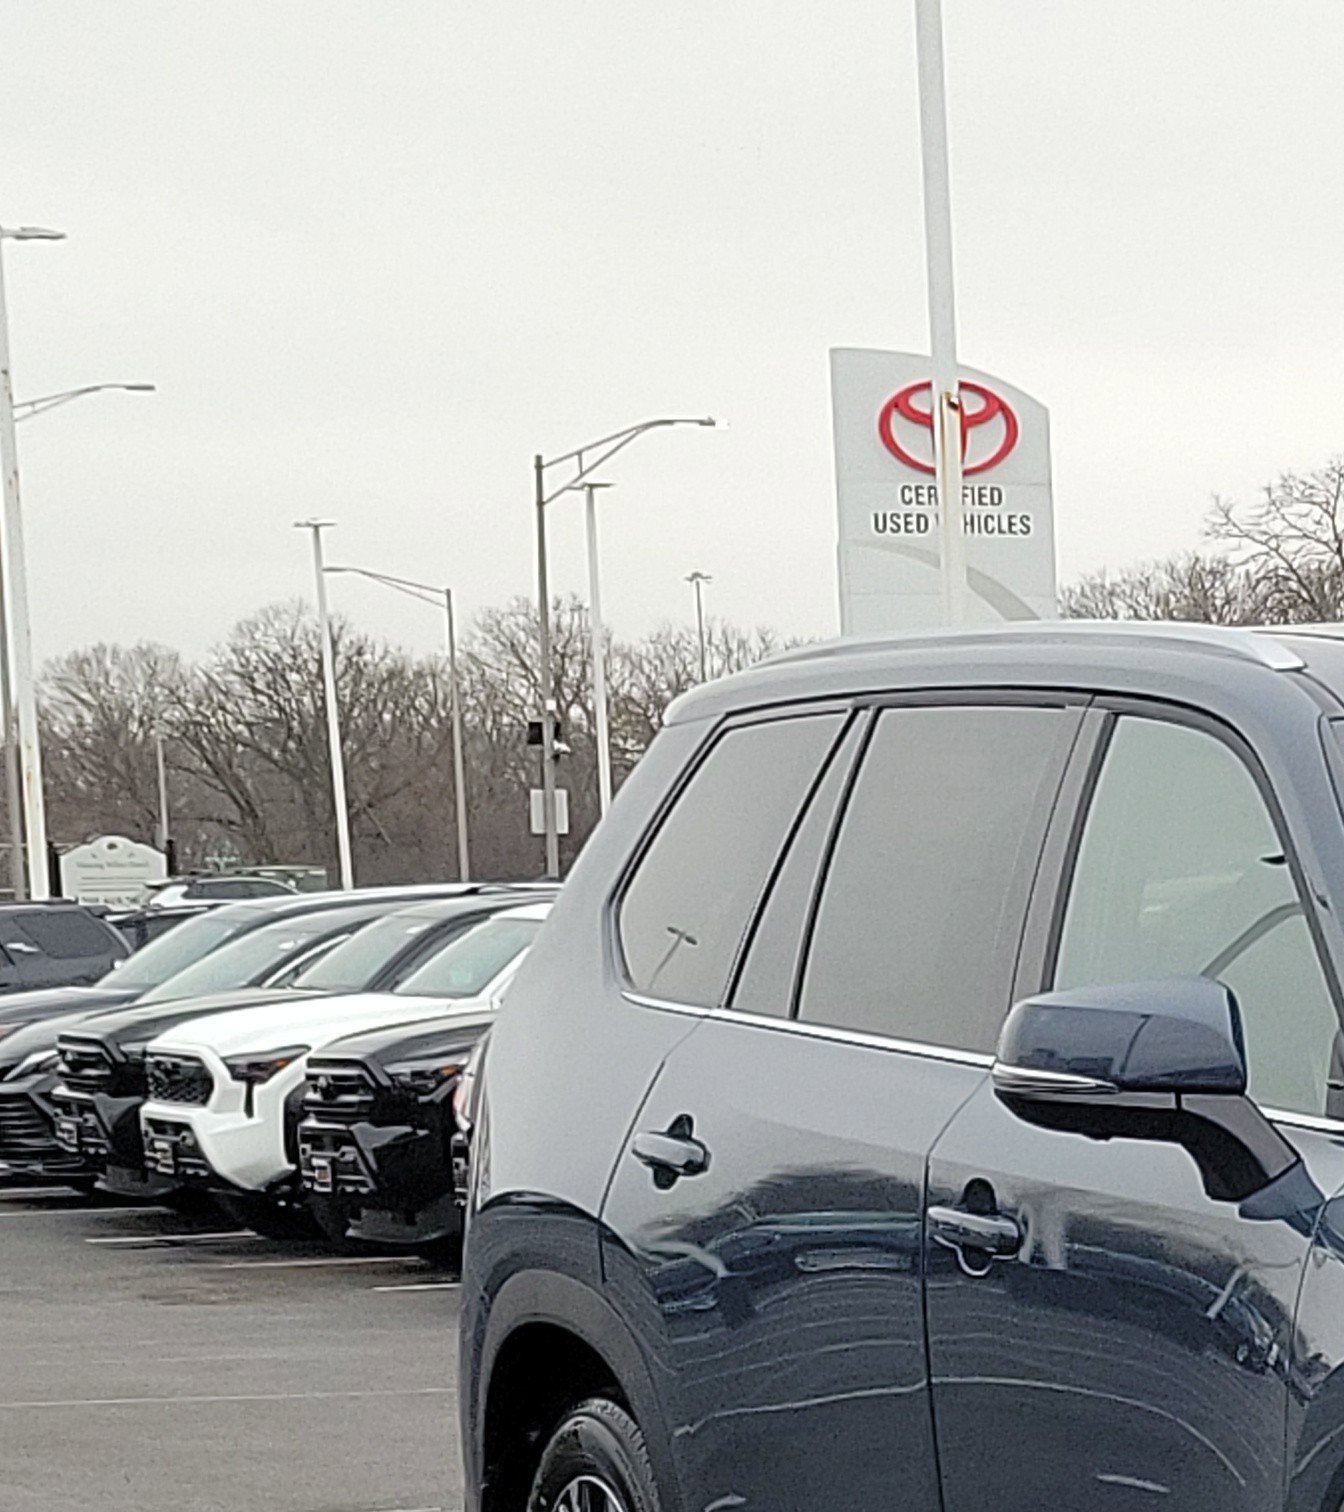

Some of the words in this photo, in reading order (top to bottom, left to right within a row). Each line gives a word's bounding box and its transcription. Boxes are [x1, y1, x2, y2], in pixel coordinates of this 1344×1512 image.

[901, 485, 1003, 506] CERFIED
[873, 513, 929, 534] USED
[935, 514, 1031, 535] HICLES
